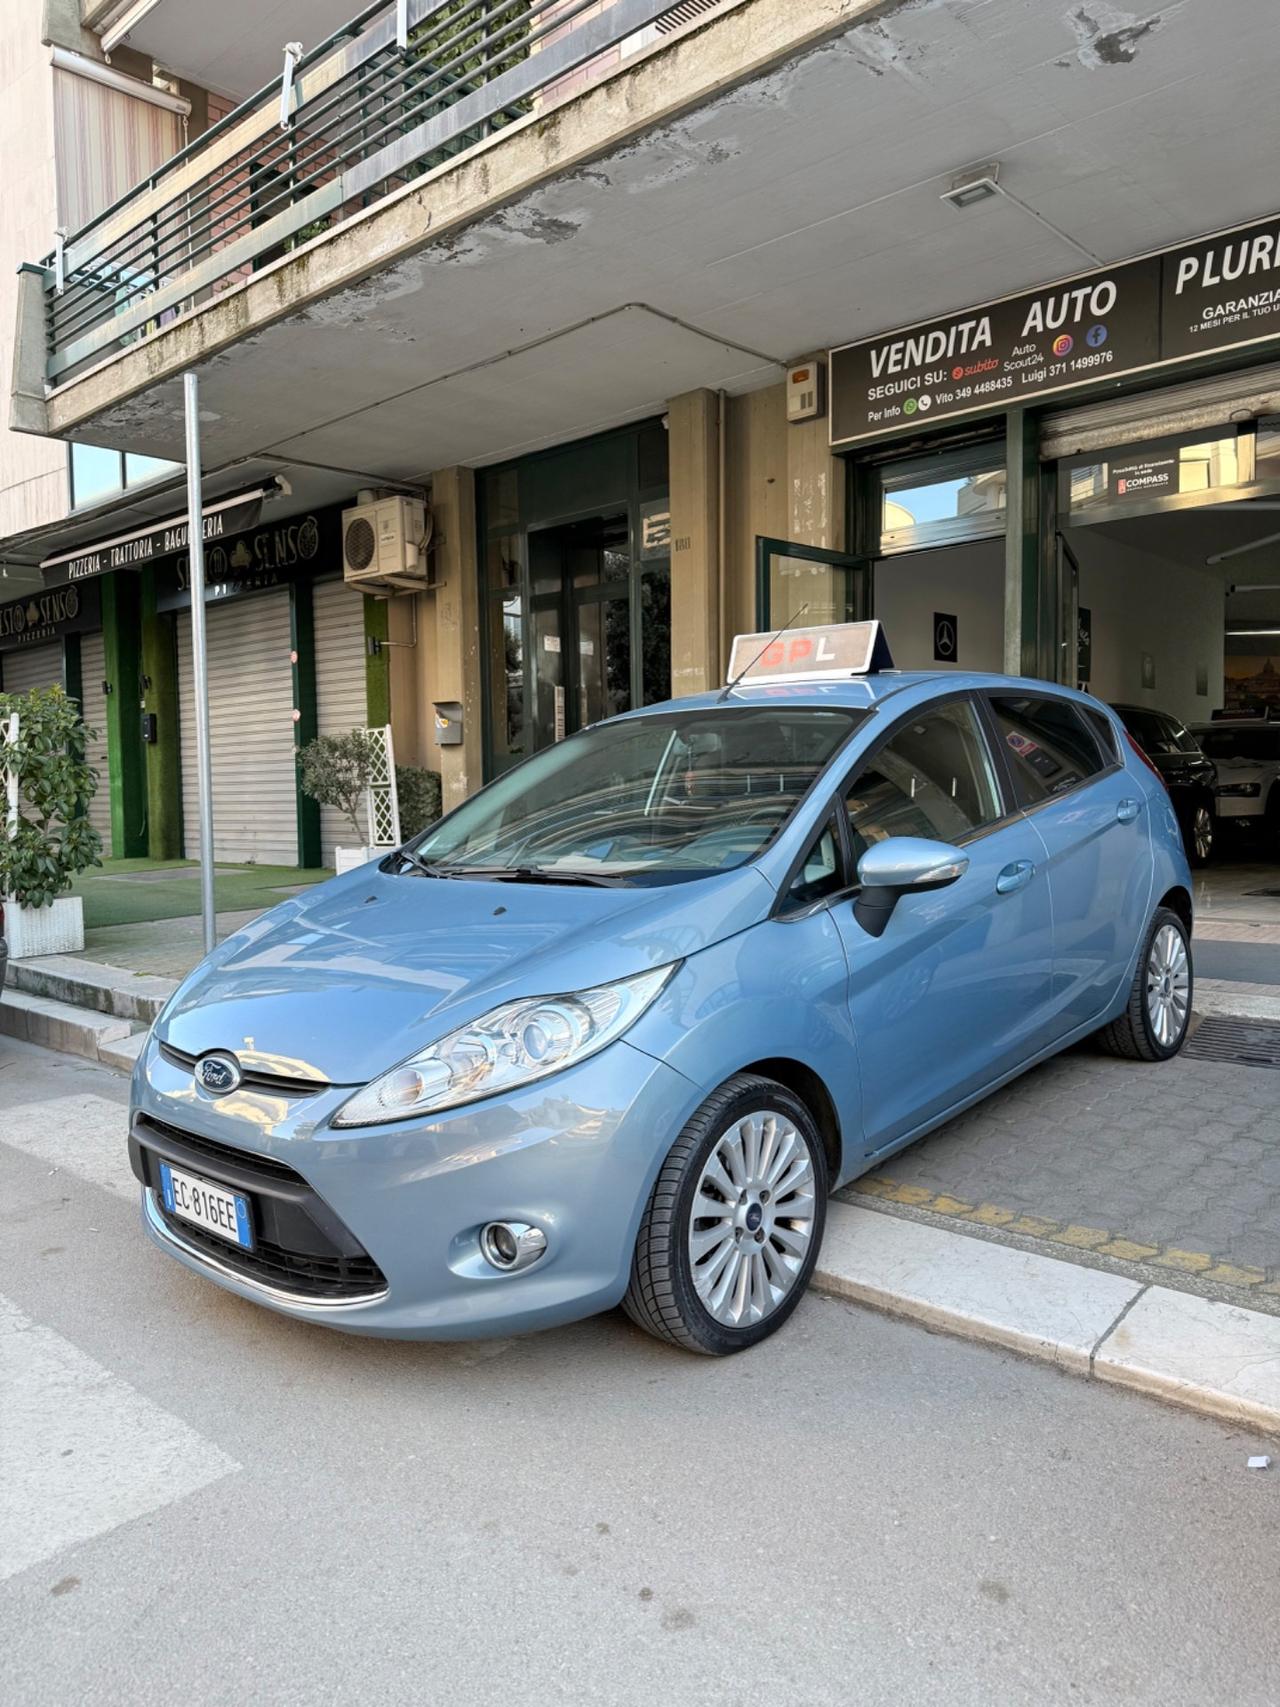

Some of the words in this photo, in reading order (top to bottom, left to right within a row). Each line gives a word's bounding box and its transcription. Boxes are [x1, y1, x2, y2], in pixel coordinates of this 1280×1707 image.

[870, 316, 992, 378] VENDITA
[1021, 280, 1117, 337] AUTO
[1189, 324, 1199, 333] 12
[1200, 319, 1221, 331] MESI
[1223, 313, 1241, 325] PER
[1242, 311, 1251, 319] IL
[1252, 306, 1271, 317] TUO
[1003, 352, 1044, 371] Scout24
[1011, 343, 1036, 357] Auto
[964, 358, 999, 376] subito
[868, 376, 921, 401] SEGUICI
[924, 369, 947, 386] SU:
[868, 411, 882, 422] Per
[884, 406, 901, 418] Info
[935, 392, 954, 404] Vito
[955, 386, 972, 399] 349
[974, 376, 1013, 395] 4488435
[1021, 367, 1047, 383] Luigi
[1049, 362, 1067, 376] 371
[1070, 350, 1113, 371] 1499976
[1126, 473, 1169, 488] COMPASS
[68, 554, 100, 580] PIZZERIA
[110, 537, 153, 567] TRATTORIA
[40, 584, 78, 625] SENSO
[760, 637, 835, 668] GPL
[203, 1061, 227, 1085] Ford
